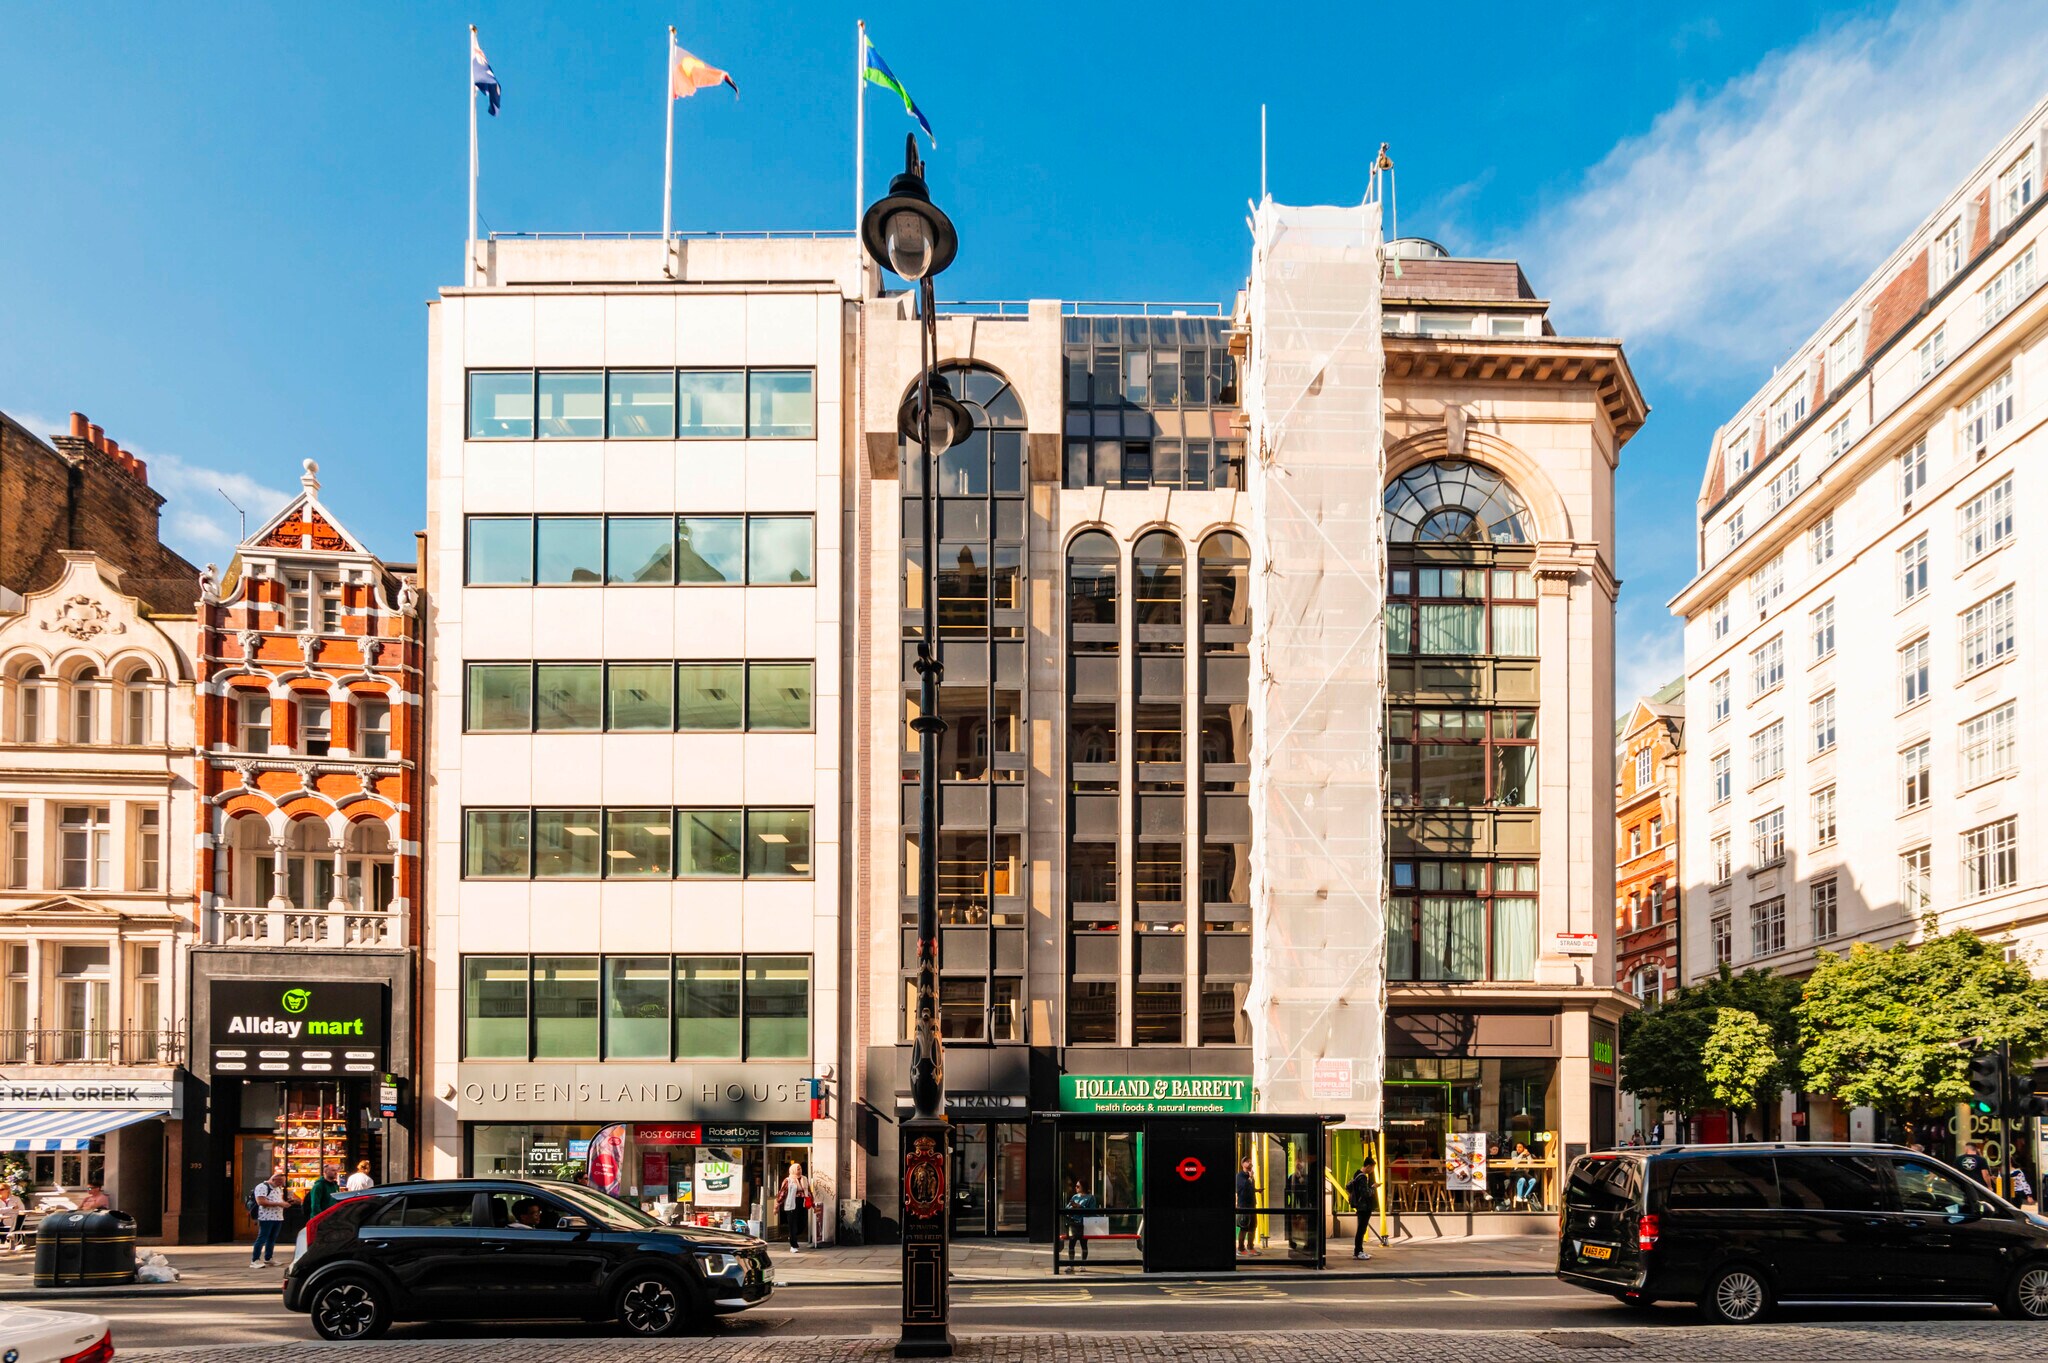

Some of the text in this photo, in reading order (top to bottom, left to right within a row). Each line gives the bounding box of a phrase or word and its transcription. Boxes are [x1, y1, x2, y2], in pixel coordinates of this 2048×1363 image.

[227, 1016, 363, 1038] Allday mart
[11, 1087, 66, 1101] REAL
[72, 1087, 140, 1101] GREEK
[464, 1083, 682, 1105] QUEENSLAND
[702, 1084, 806, 1102] HOUSE
[1075, 1079, 1244, 1100] HOLLAND & BARRETT
[1096, 1104, 1224, 1112] health foods & natural remedies
[640, 1130, 696, 1138] POST OFFICE
[708, 1127, 760, 1137] Robert Dyas
[529, 1153, 544, 1161] TO
[545, 1153, 563, 1161] LET
[705, 1162, 729, 1174] UNI
